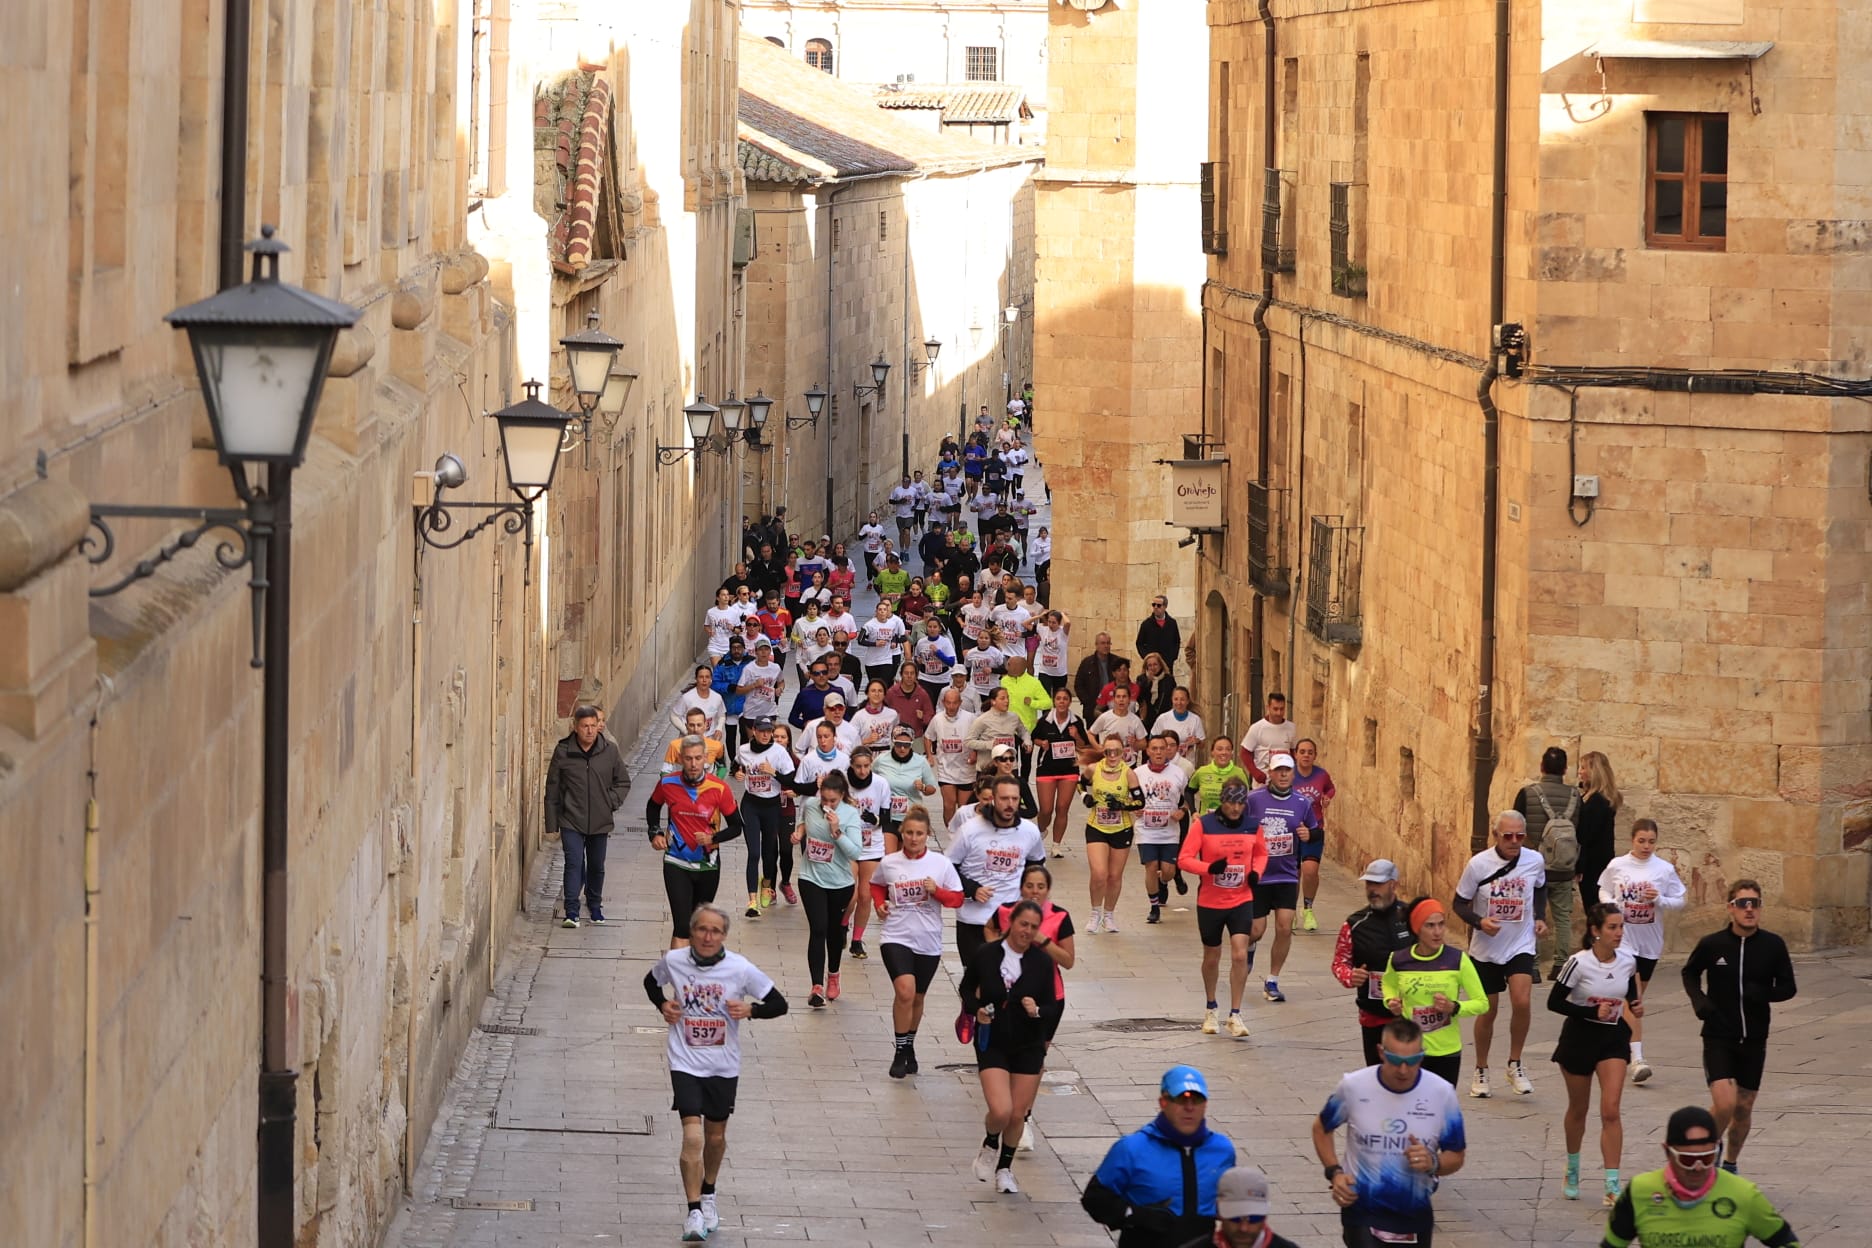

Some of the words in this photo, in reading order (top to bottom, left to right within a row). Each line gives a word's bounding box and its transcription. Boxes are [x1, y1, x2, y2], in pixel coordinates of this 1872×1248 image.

[1151, 815, 1162, 823] 84
[1271, 840, 1288, 850] 295
[811, 846, 828, 858] 347
[992, 856, 1012, 867] 290
[1220, 872, 1239, 882] 397
[903, 886, 922, 897] 302
[1496, 904, 1517, 915] 207
[1630, 909, 1650, 919] 344
[684, 1017, 727, 1028] bedunia
[692, 1027, 717, 1039] 537
